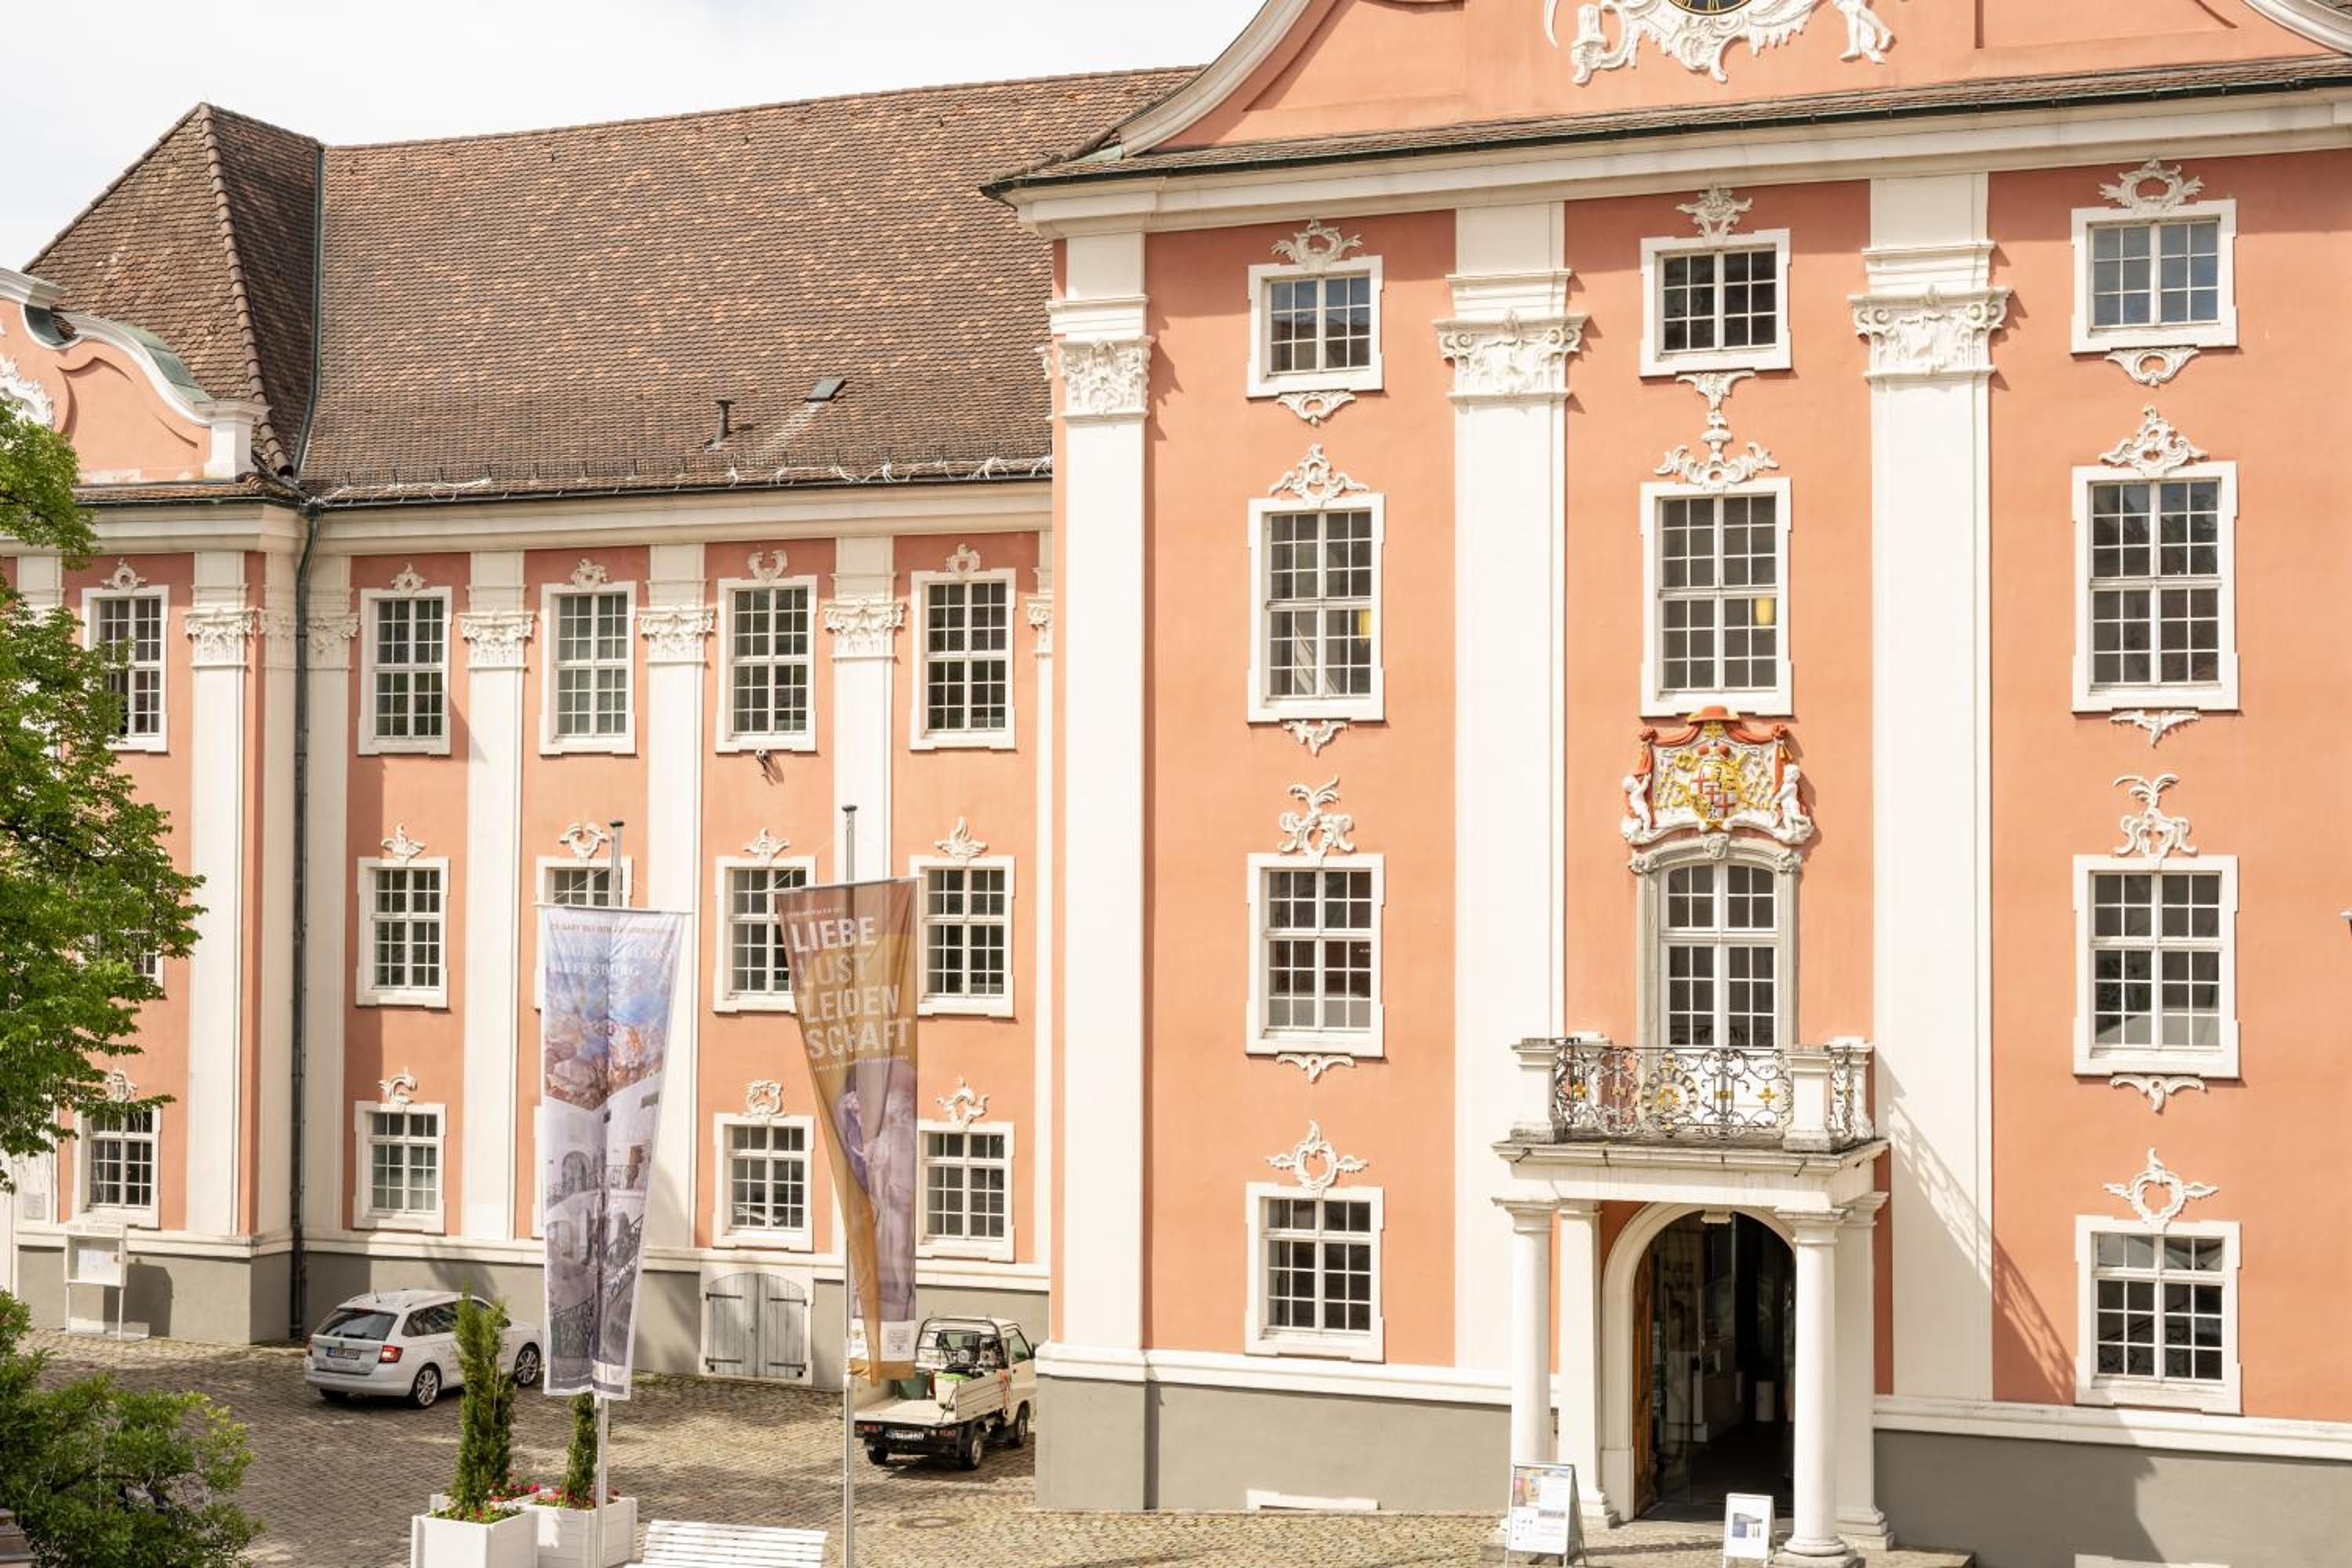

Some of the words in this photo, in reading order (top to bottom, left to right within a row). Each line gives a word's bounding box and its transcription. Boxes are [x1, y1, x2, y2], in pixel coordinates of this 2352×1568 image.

[790, 916, 877, 953] LIEBE
[800, 984, 899, 1023] LEIDEN
[806, 1017, 912, 1060] SCHAFT
